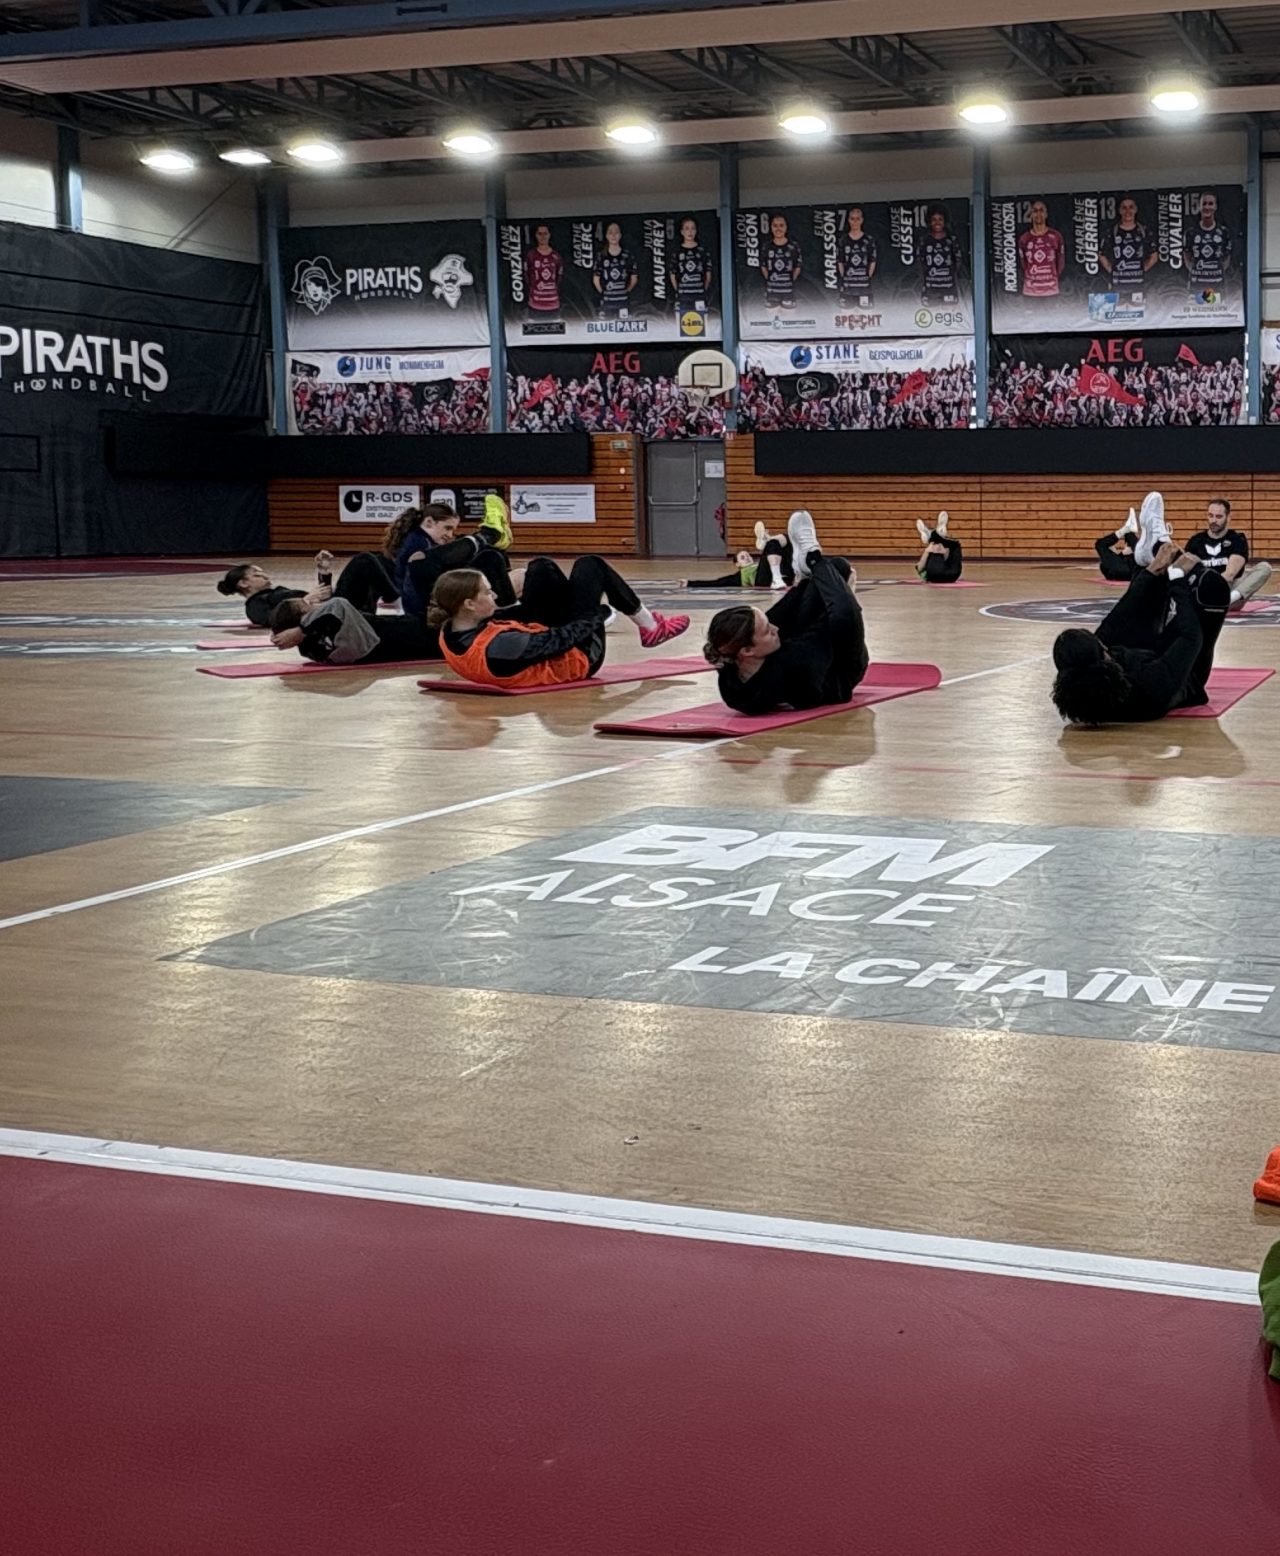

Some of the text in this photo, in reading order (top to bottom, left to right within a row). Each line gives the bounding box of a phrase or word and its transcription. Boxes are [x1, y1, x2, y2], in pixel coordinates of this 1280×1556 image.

[891, 206, 900, 249] LOUISE
[1002, 202, 1016, 232] COSTA
[1016, 201, 1032, 223] 12
[1100, 197, 1116, 220] 13
[1158, 194, 1169, 262] CORENTINE
[1168, 193, 1183, 269] CAVALIER
[581, 222, 593, 268] CLERC
[746, 213, 760, 267] BEGON
[823, 210, 838, 289] KARLSSON
[900, 206, 914, 265] CUSSET
[1084, 198, 1098, 275] GUERRIER
[345, 266, 423, 296] PIRATHS
[509, 225, 524, 302] GONZALEZ
[652, 219, 667, 300] MAUFFREY
[1003, 247, 1018, 292] RODRIGO
[935, 310, 963, 327] egis
[0, 325, 169, 392] PIRATHS
[359, 356, 393, 371] JUNG
[591, 351, 641, 374] AEG
[815, 343, 924, 361] STANE GEISPOLSHEIM
[1086, 338, 1144, 363] AEG
[365, 491, 413, 503] R-GDS
[550, 824, 1058, 887] BFM
[449, 869, 976, 927] ALSACE
[668, 946, 815, 980] LA
[833, 957, 1276, 1015] CHAÎNE
